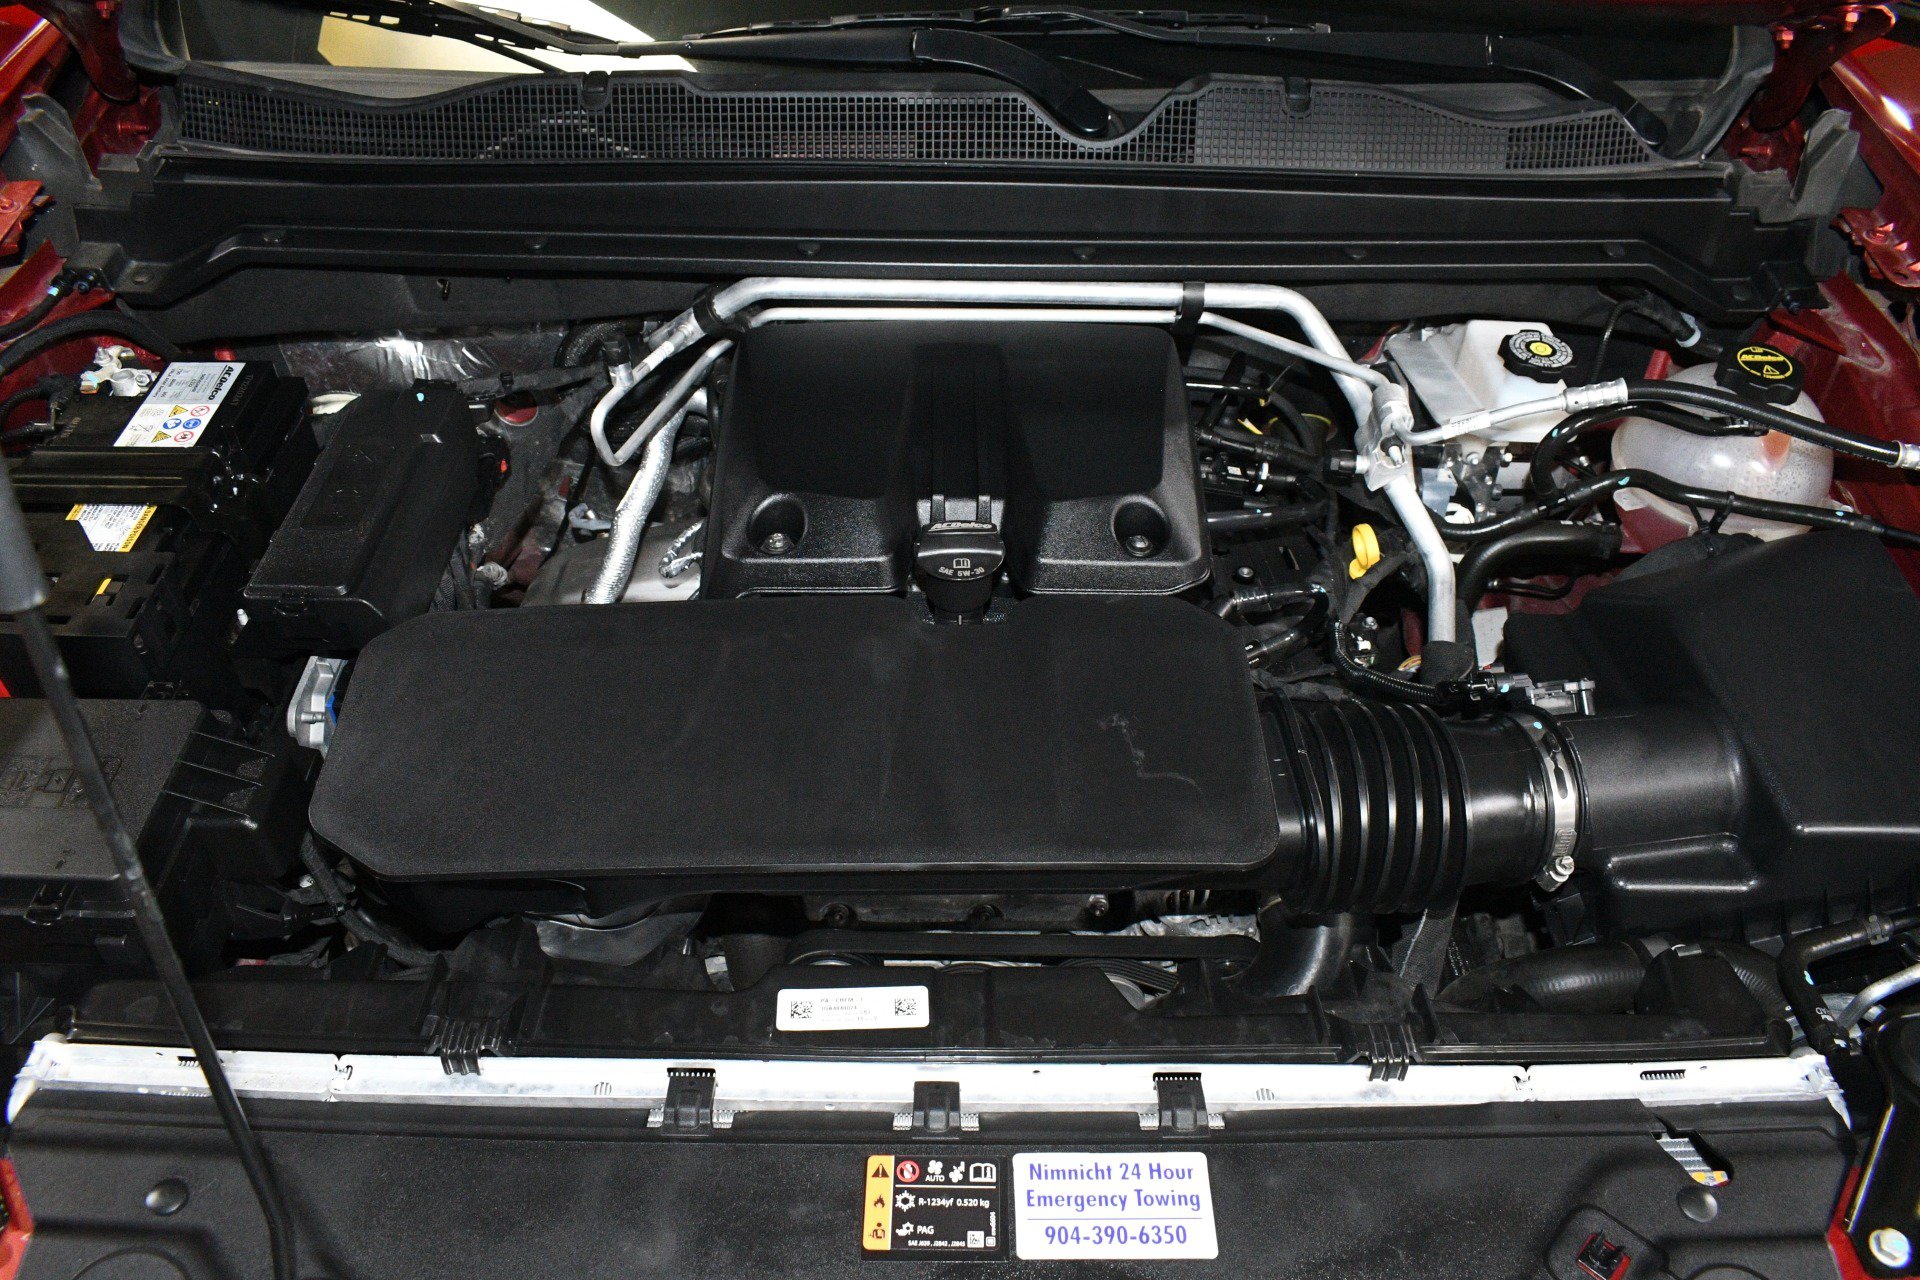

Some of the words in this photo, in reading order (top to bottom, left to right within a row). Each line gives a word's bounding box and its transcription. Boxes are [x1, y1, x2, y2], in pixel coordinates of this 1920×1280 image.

[208, 365, 236, 401] ACDelco
[938, 566, 954, 576] SAE
[957, 566, 985, 577] 5W-30
[1029, 1161, 1113, 1181] Nimnicht
[1118, 1162, 1141, 1181] 24
[1148, 1162, 1193, 1181] Hour
[919, 1198, 953, 1208] R-1234yf
[957, 1198, 978, 1206] 0.520
[980, 1198, 989, 1208] kg
[1027, 1188, 1128, 1213] Emergency
[1134, 1188, 1201, 1213] Towing
[917, 1226, 934, 1234] PAG
[1044, 1225, 1188, 1246] 904-390-6350
